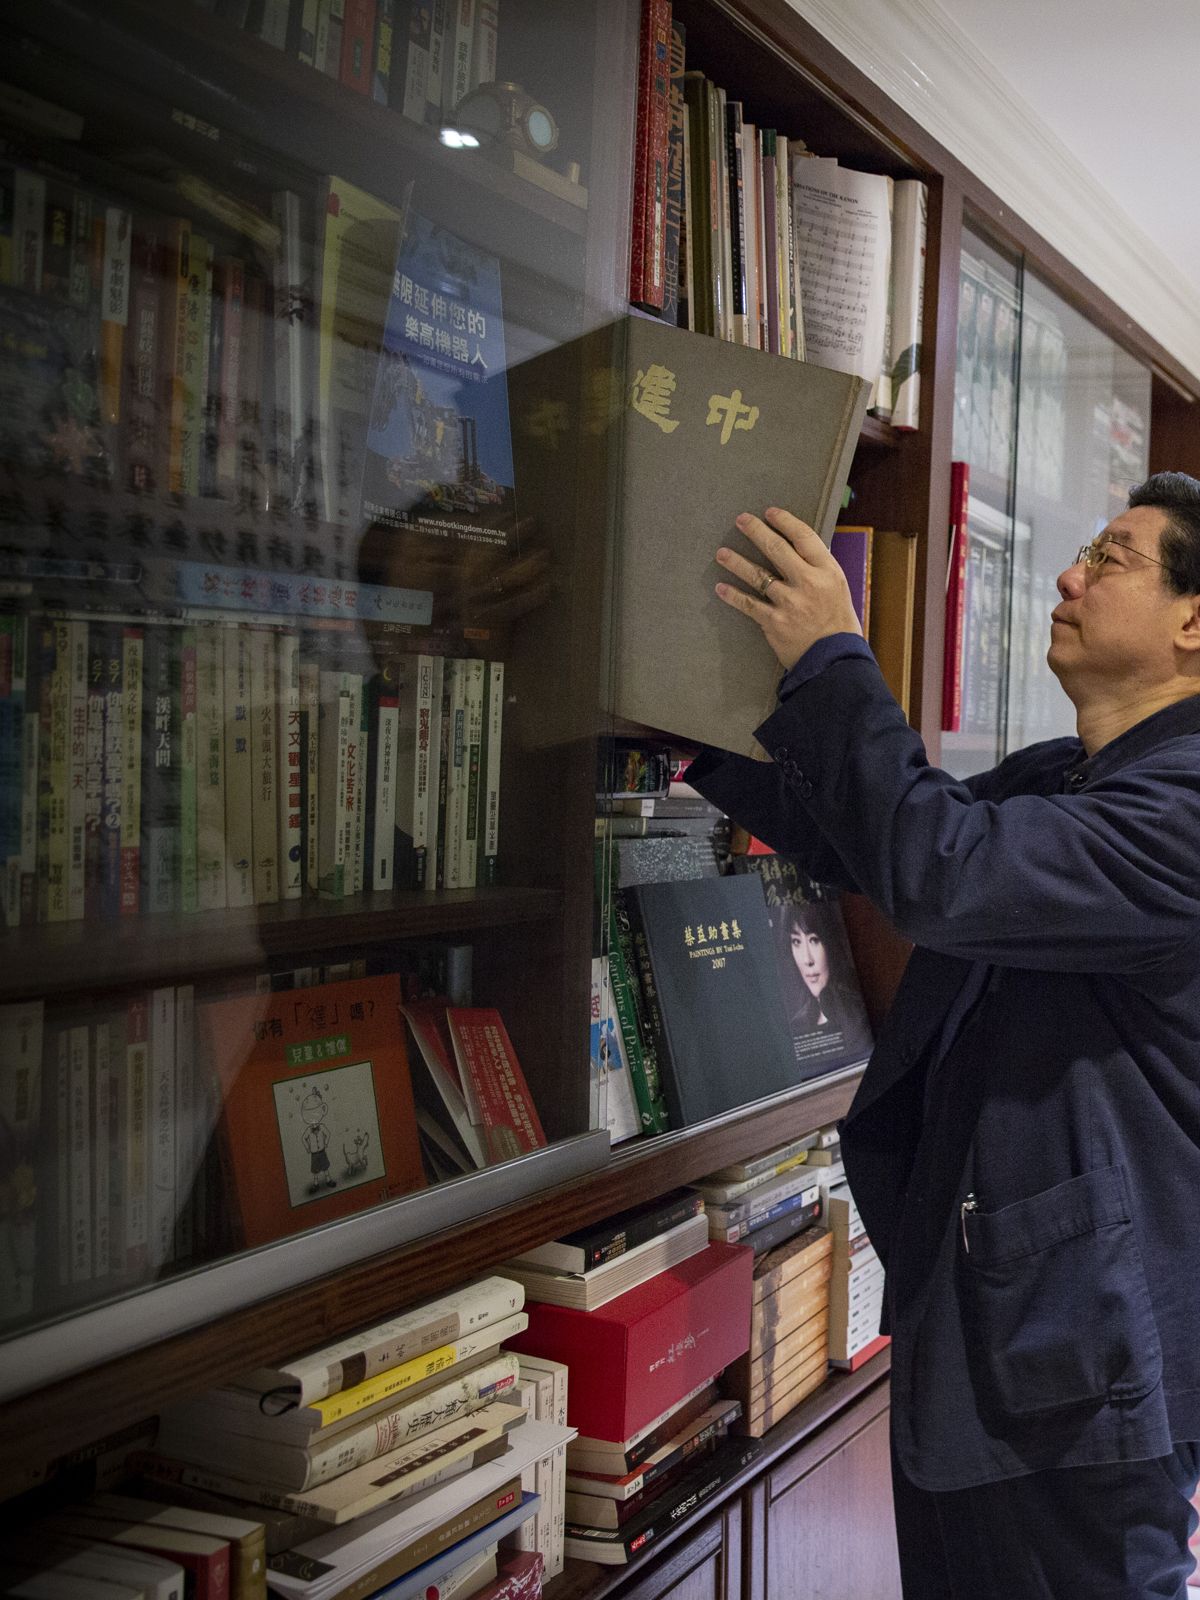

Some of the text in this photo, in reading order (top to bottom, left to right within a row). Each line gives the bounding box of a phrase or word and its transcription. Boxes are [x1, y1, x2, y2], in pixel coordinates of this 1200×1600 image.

[405, 314, 488, 369] 樂高機器人
[711, 957, 726, 969] 2007
[608, 951, 627, 1011] Gardens
[624, 1034, 638, 1073] Paris
[406, 1397, 469, 1436] 人類大歷史
